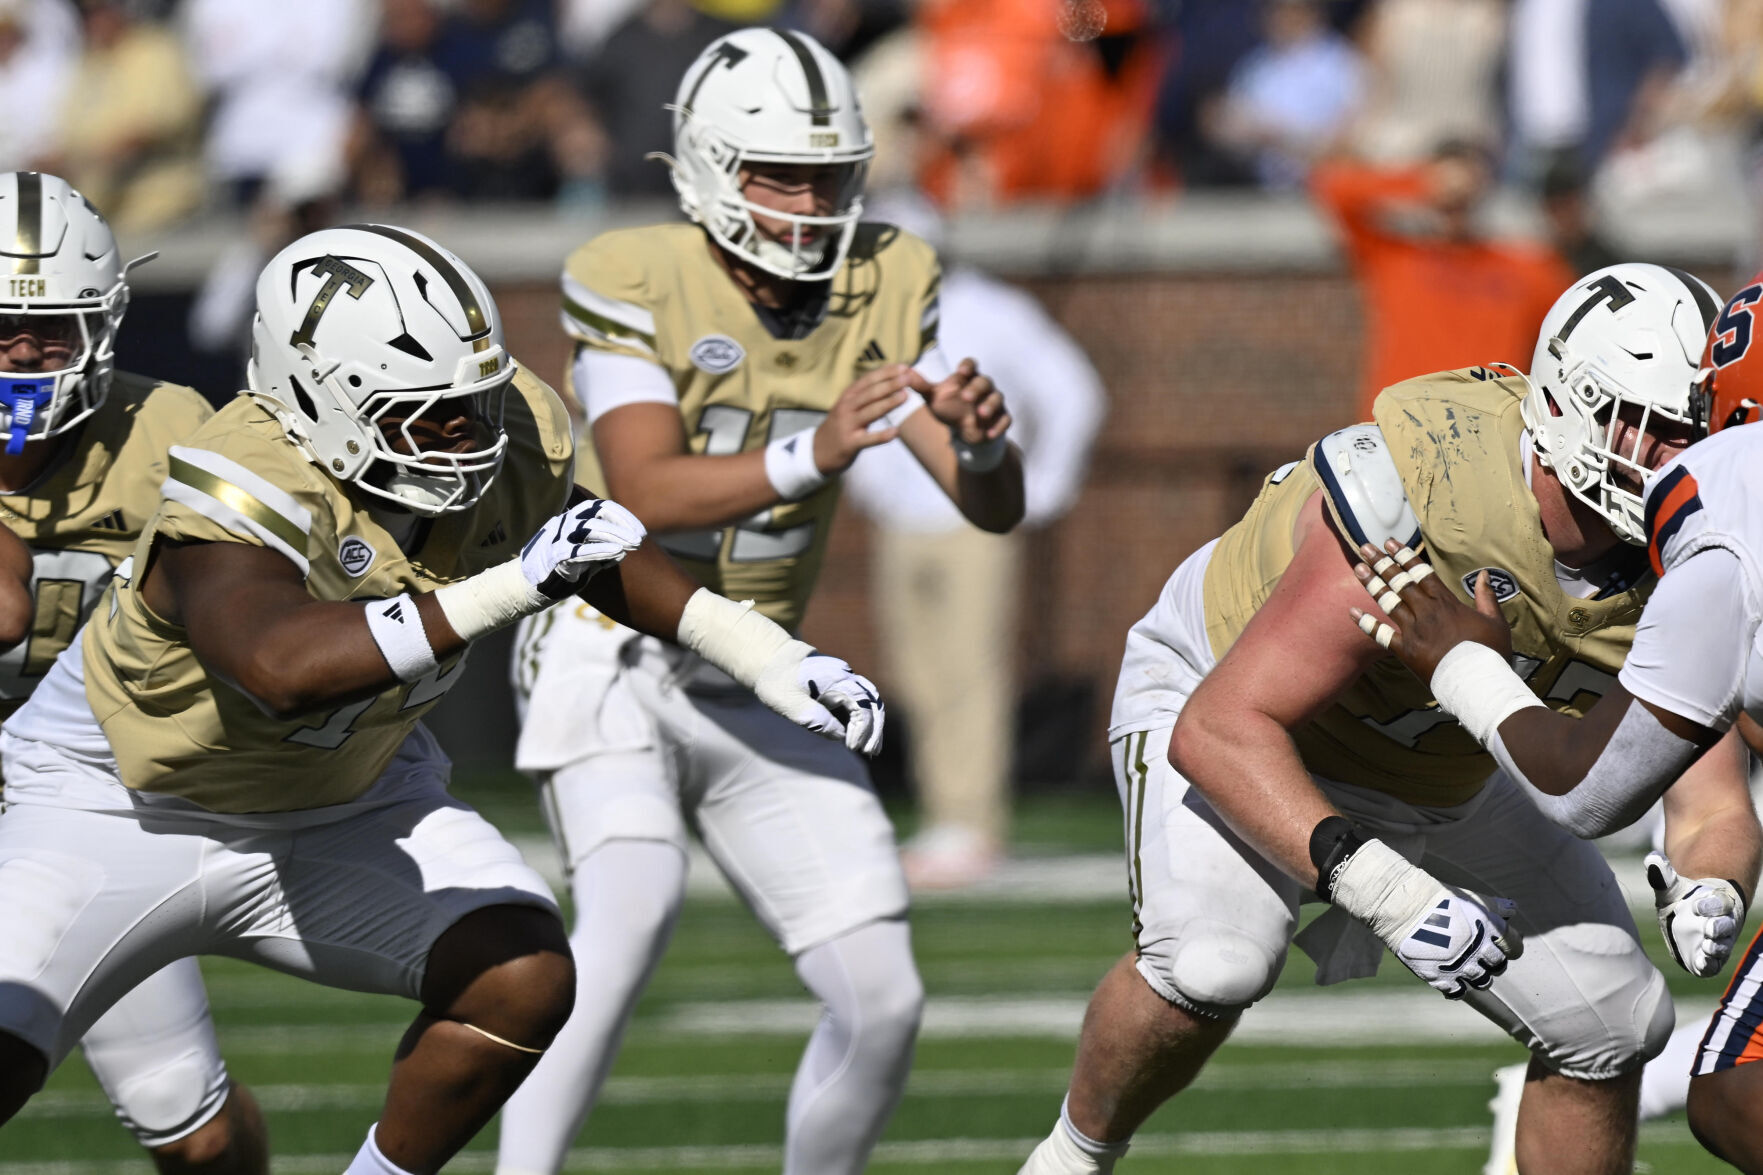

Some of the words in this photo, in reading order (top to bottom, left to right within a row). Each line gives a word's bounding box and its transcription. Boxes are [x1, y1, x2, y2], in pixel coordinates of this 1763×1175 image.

[324, 260, 366, 287] GEORGIA
[9, 279, 46, 297] TECH
[1711, 283, 1763, 371] S
